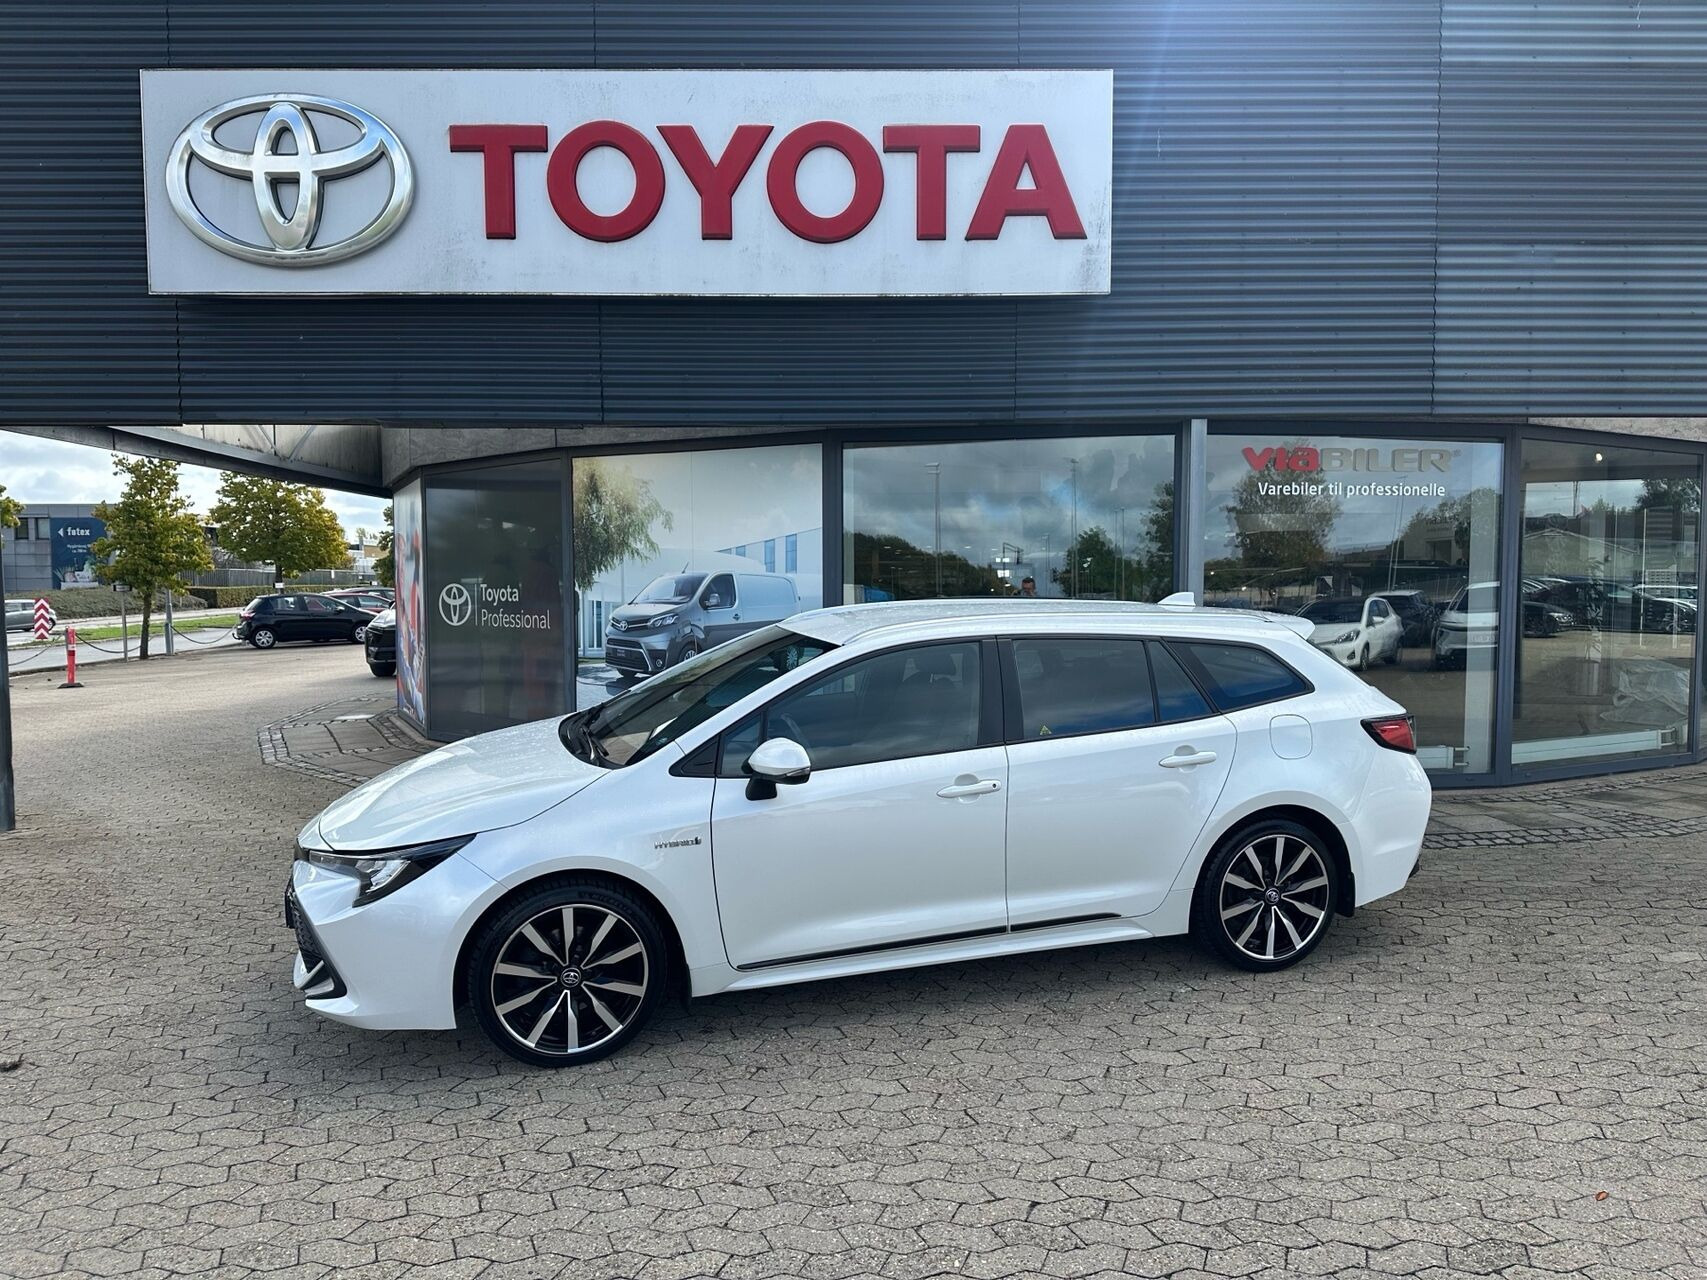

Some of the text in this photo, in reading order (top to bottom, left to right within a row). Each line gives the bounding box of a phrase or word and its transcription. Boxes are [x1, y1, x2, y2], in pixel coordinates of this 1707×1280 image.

[449, 120, 1088, 243] TOYOTA
[1257, 481, 1446, 498] Varebiler til professionelle
[480, 583, 519, 606] Toyota
[481, 608, 551, 630] Professional
